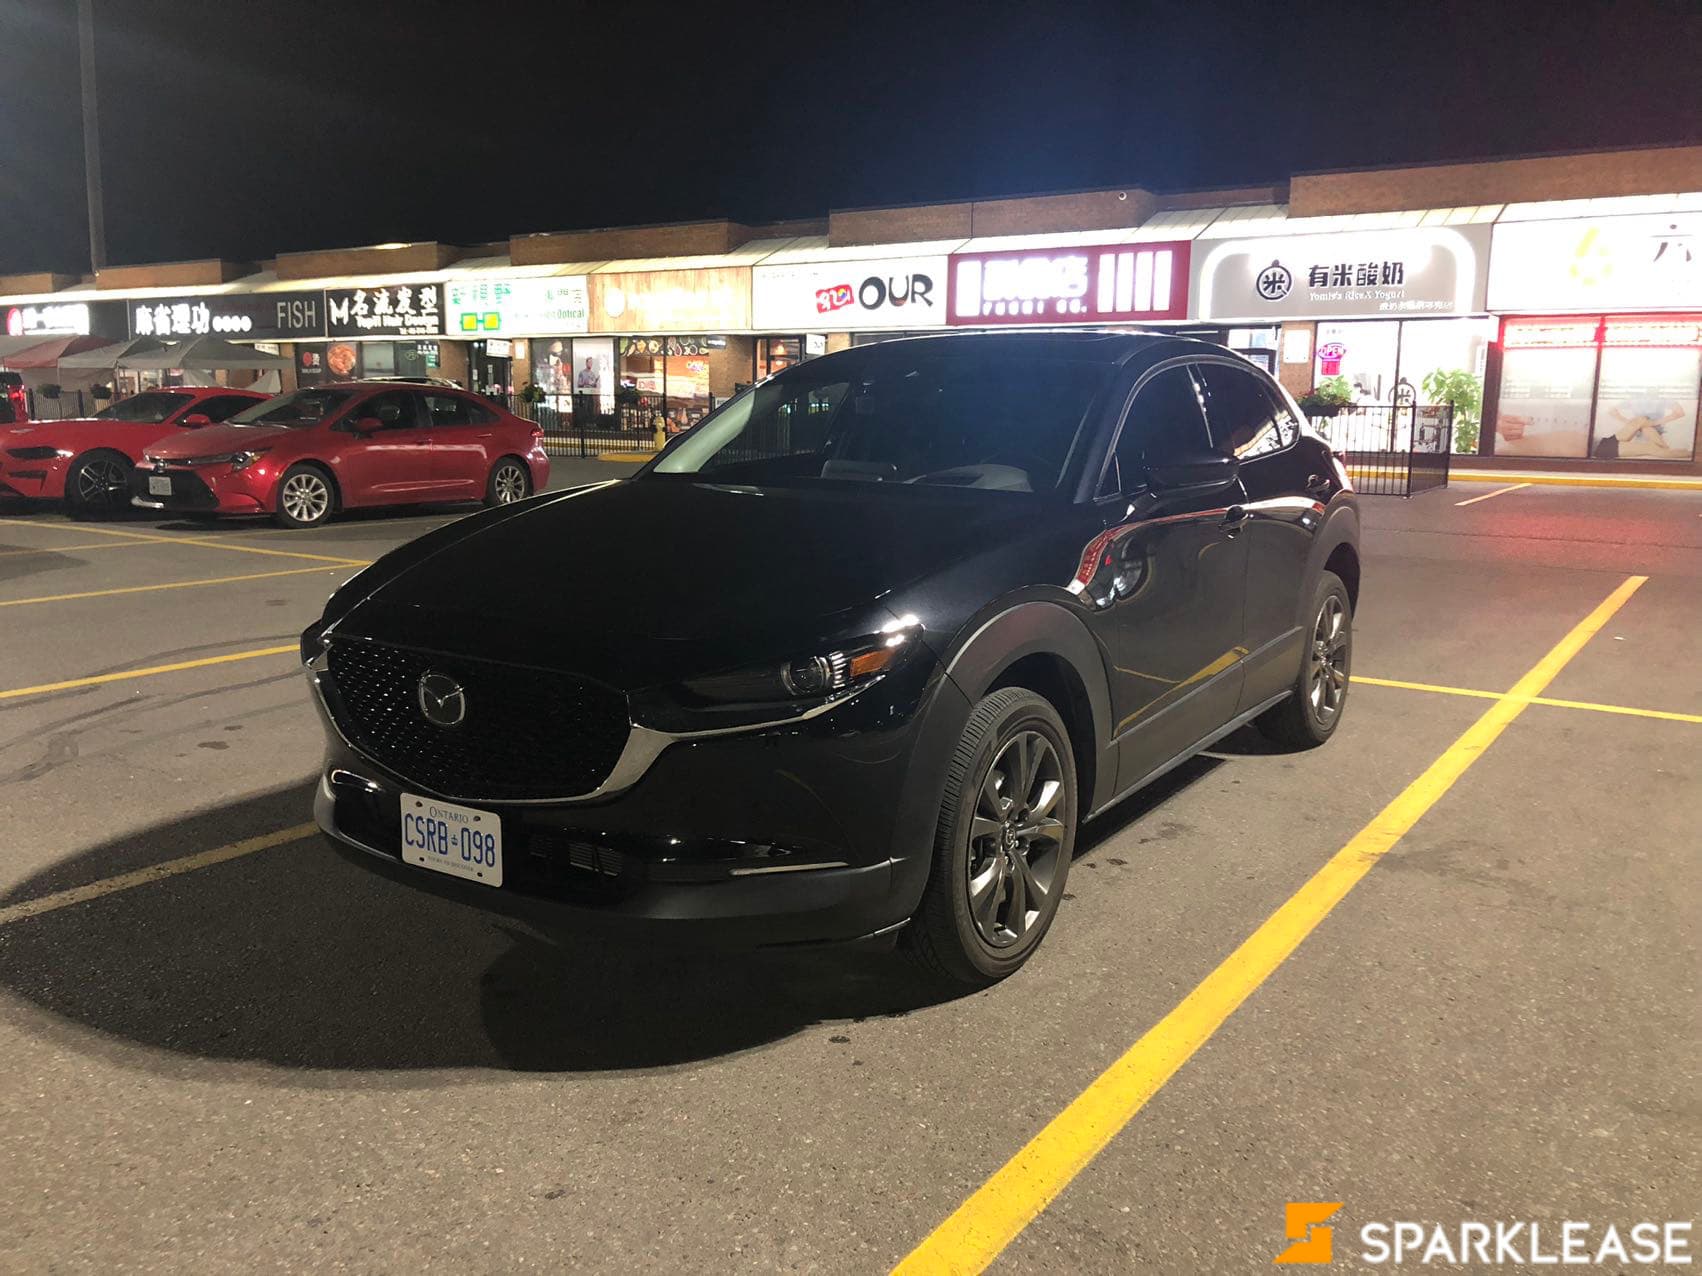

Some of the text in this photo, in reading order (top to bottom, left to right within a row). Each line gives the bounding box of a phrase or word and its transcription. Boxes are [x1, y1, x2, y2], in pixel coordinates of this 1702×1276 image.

[1308, 262, 1405, 288] 有米酸奶
[858, 273, 934, 310] OUR
[276, 300, 317, 329] FISH
[329, 297, 350, 326] M
[429, 806, 469, 824] ONTARIO
[404, 812, 496, 868] CSRB 098
